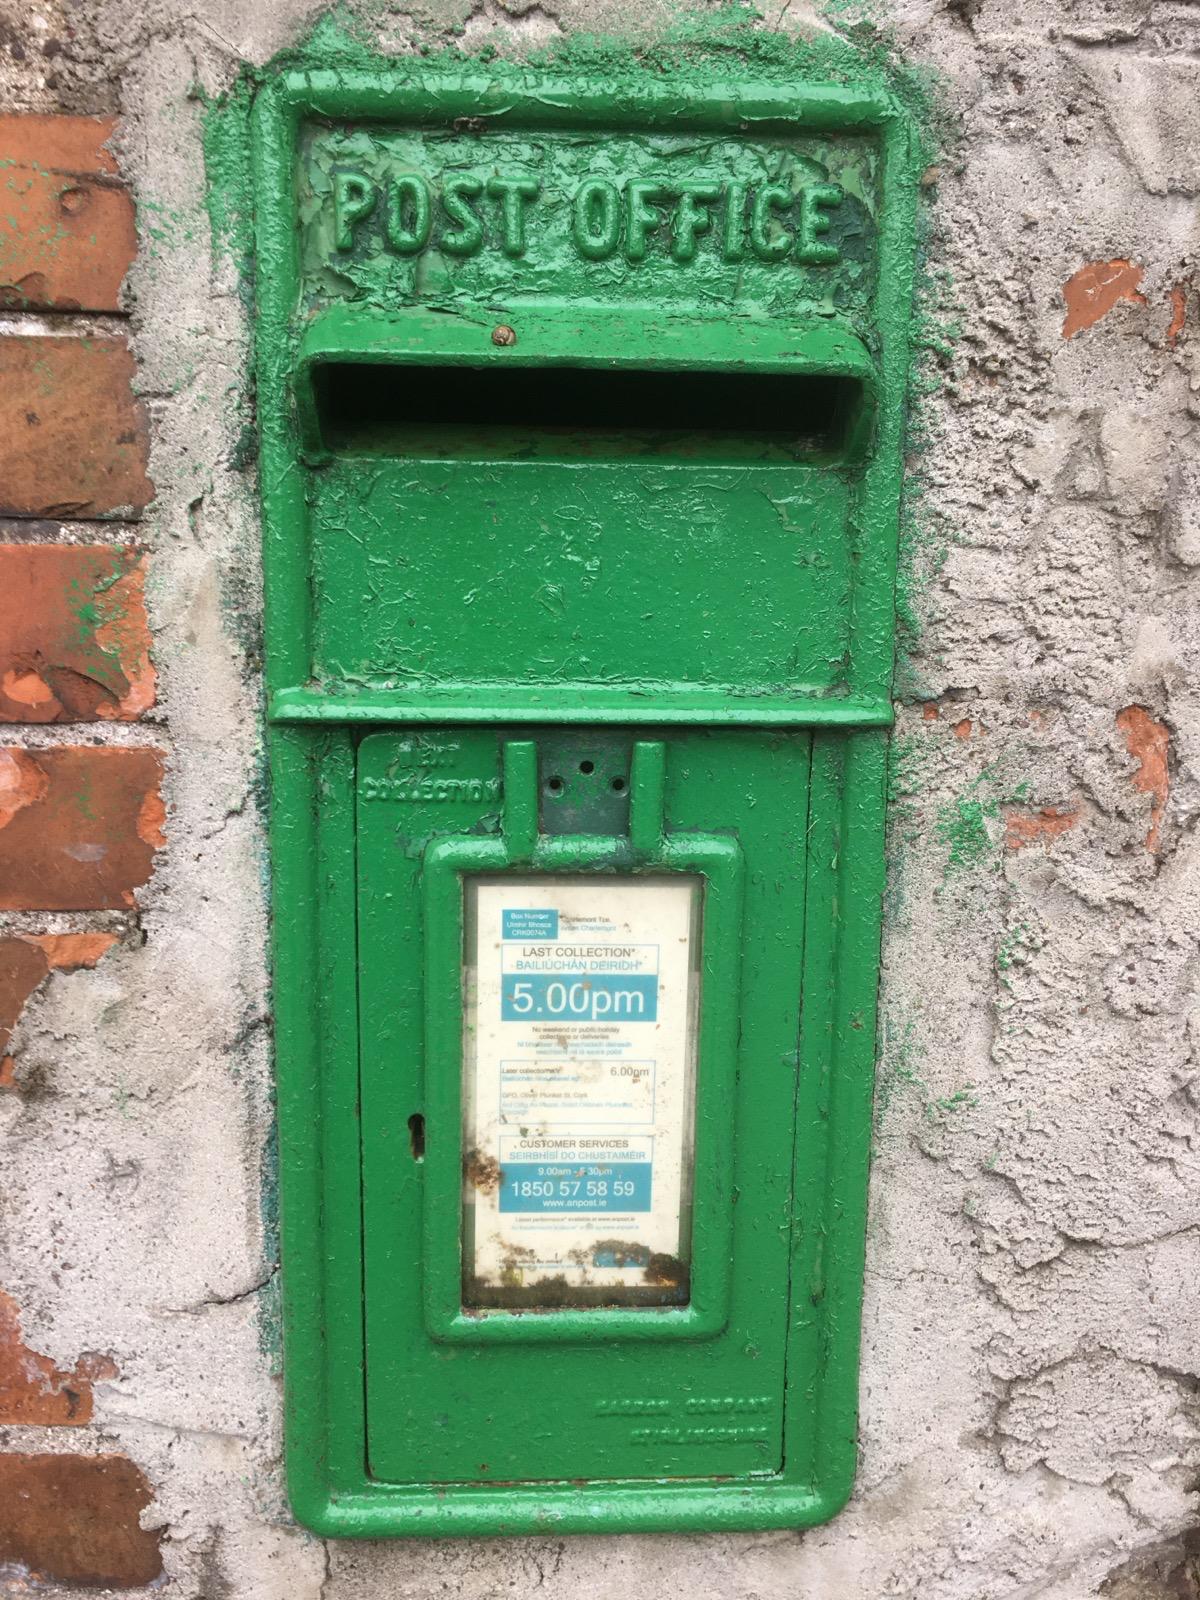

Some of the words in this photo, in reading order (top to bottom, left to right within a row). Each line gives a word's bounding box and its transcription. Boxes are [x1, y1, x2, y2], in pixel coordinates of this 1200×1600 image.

[334, 171, 538, 257] POST
[572, 175, 844, 266] OFFICE
[523, 947, 554, 958] LAST
[516, 958, 587, 970] BAILIÚCHÁN
[512, 982, 645, 1021] 5.00pm
[610, 1066, 650, 1078] 6.00pm
[519, 1139, 577, 1149] CUSTOMER
[578, 1139, 630, 1149] SERVICES
[560, 1151, 576, 1160] DO
[537, 1167, 572, 1176] 9.00am
[579, 1167, 613, 1177] 530pm
[511, 1181, 554, 1197] 1850
[559, 1181, 581, 1197] 57
[586, 1181, 608, 1197] 58
[613, 1181, 635, 1197] 59
[542, 1199, 607, 1208] www.anpost.ie
